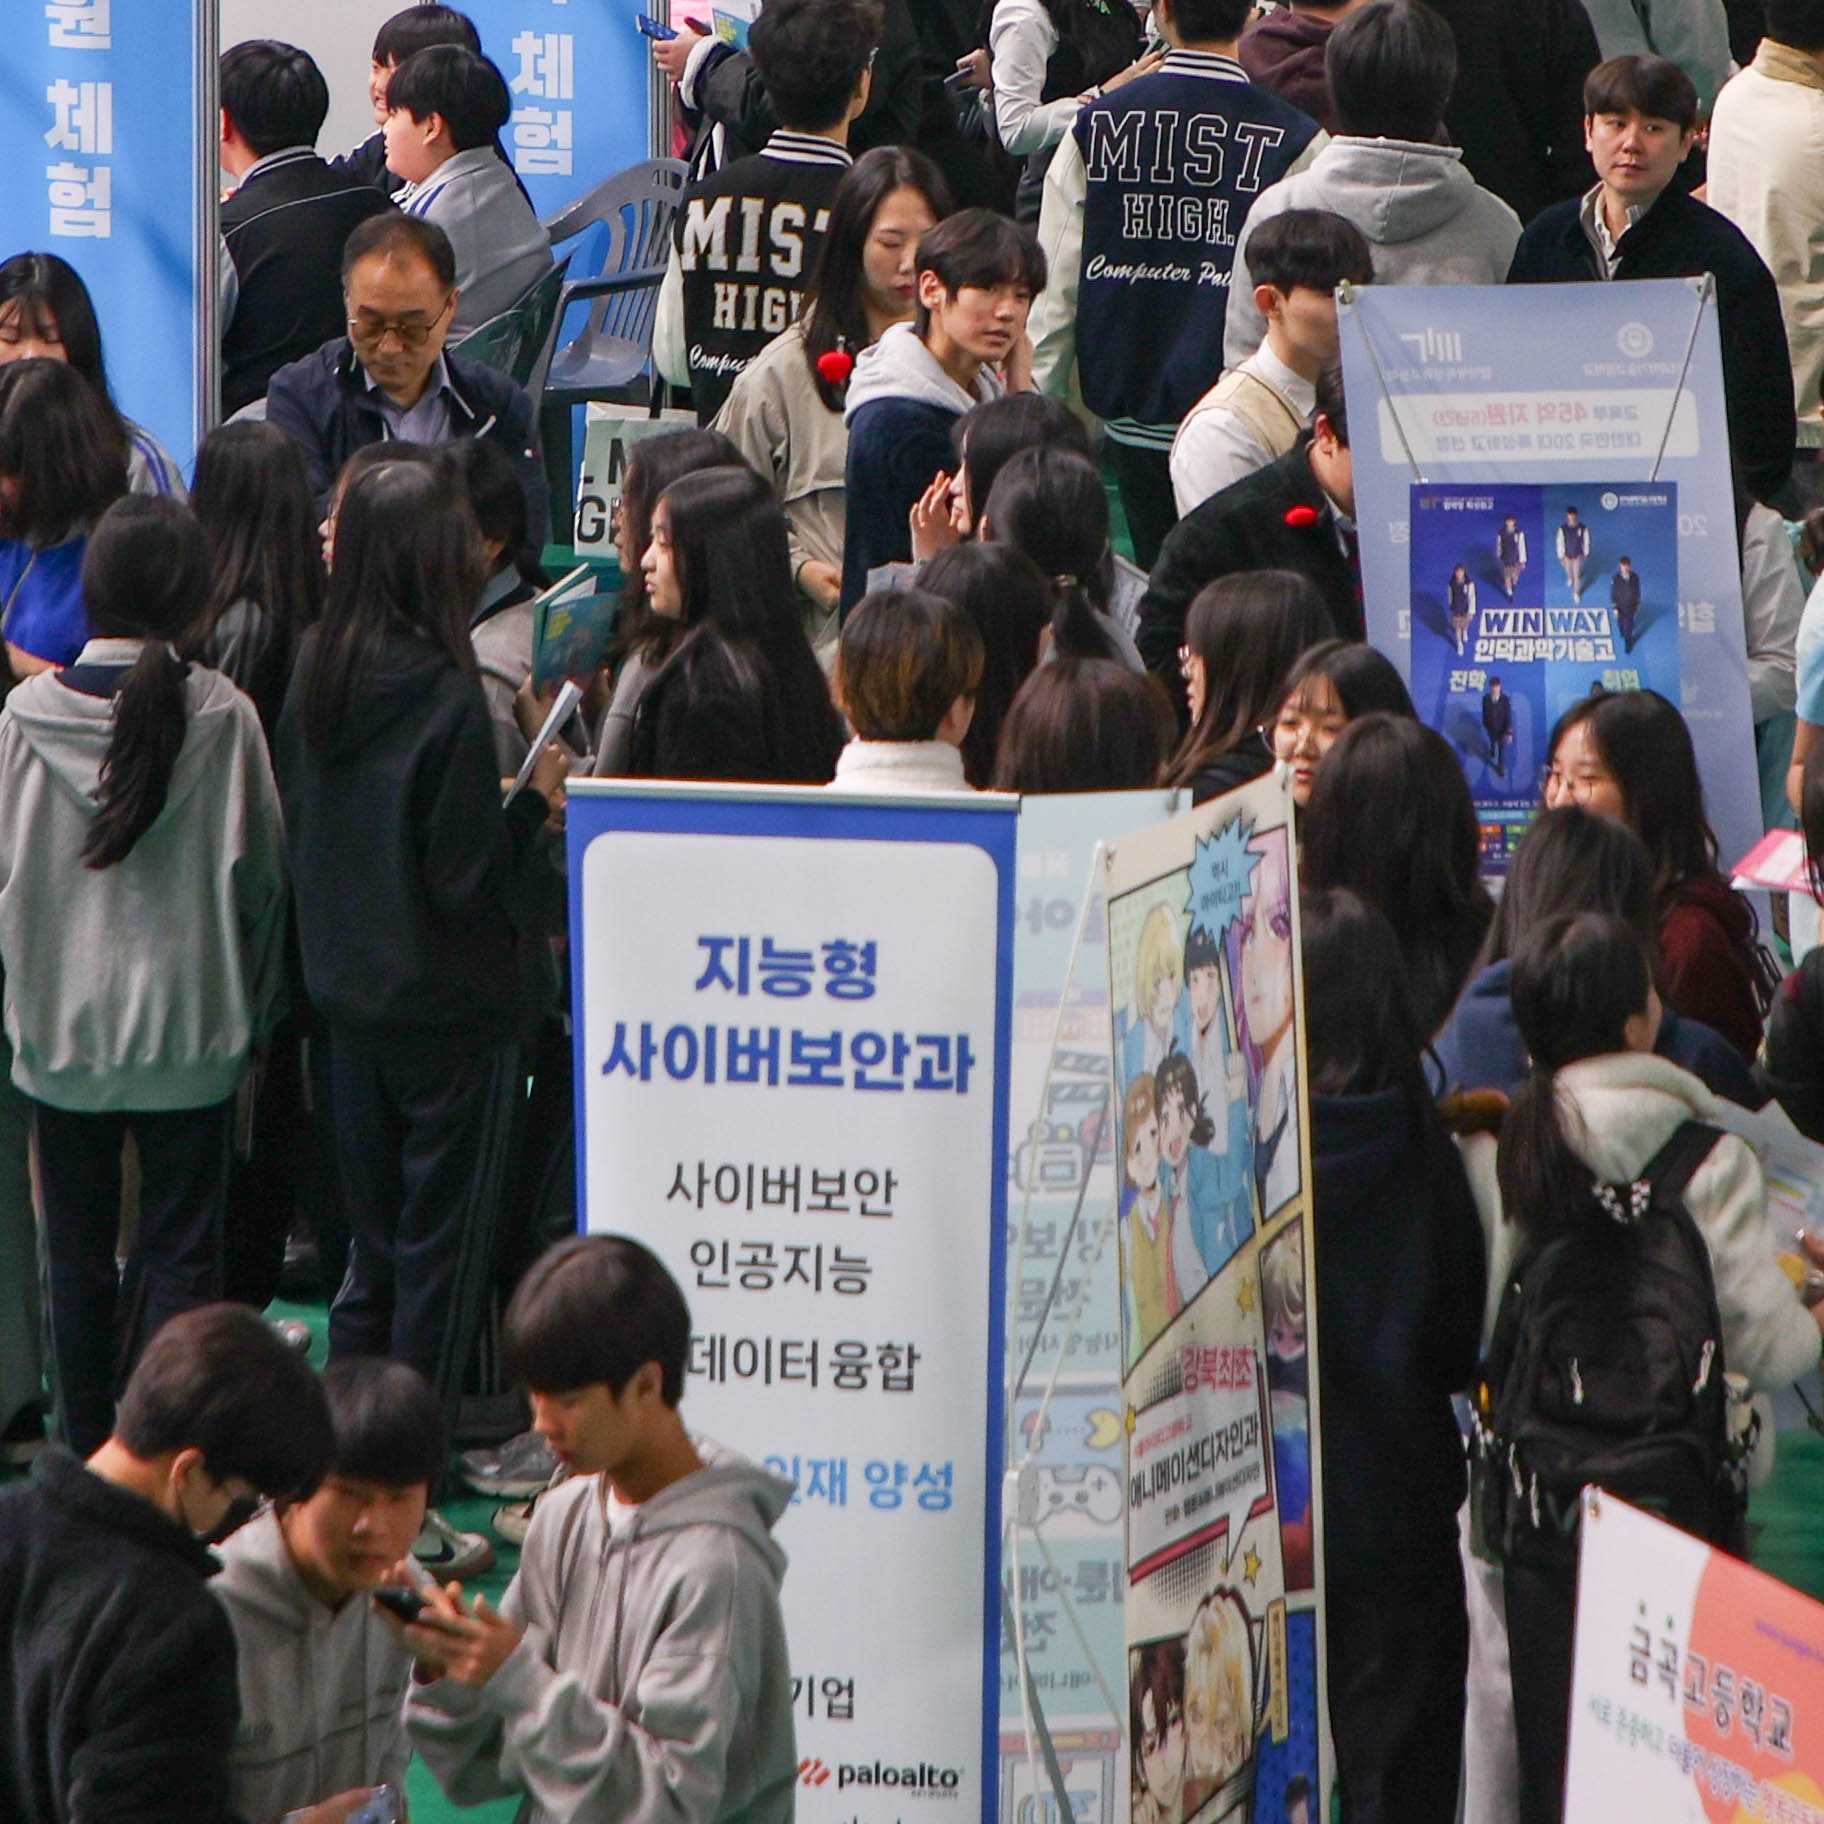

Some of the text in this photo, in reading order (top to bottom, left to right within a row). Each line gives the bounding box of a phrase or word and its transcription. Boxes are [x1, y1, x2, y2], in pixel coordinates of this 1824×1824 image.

[510, 30, 574, 177] 체험
[44, 78, 113, 239] 체험
[1087, 111, 1285, 192] MIST
[1123, 193, 1235, 246] HIGH.
[1086, 254, 1191, 284] Computer
[1474, 637, 1616, 663] 인덕과학기술고
[1485, 610, 1605, 633] WIN WAY
[695, 935, 877, 1001] 지능형
[601, 1021, 975, 1094] 사이버보안과
[667, 1161, 898, 1219] 사이버보안
[690, 1238, 873, 1296] 인공지능
[1183, 1346, 1254, 1393] 강북최초
[865, 1460, 954, 1511] 양성
[1131, 1413, 1259, 1508] 애니메이션디자인과
[838, 1761, 960, 1791] paloalto
